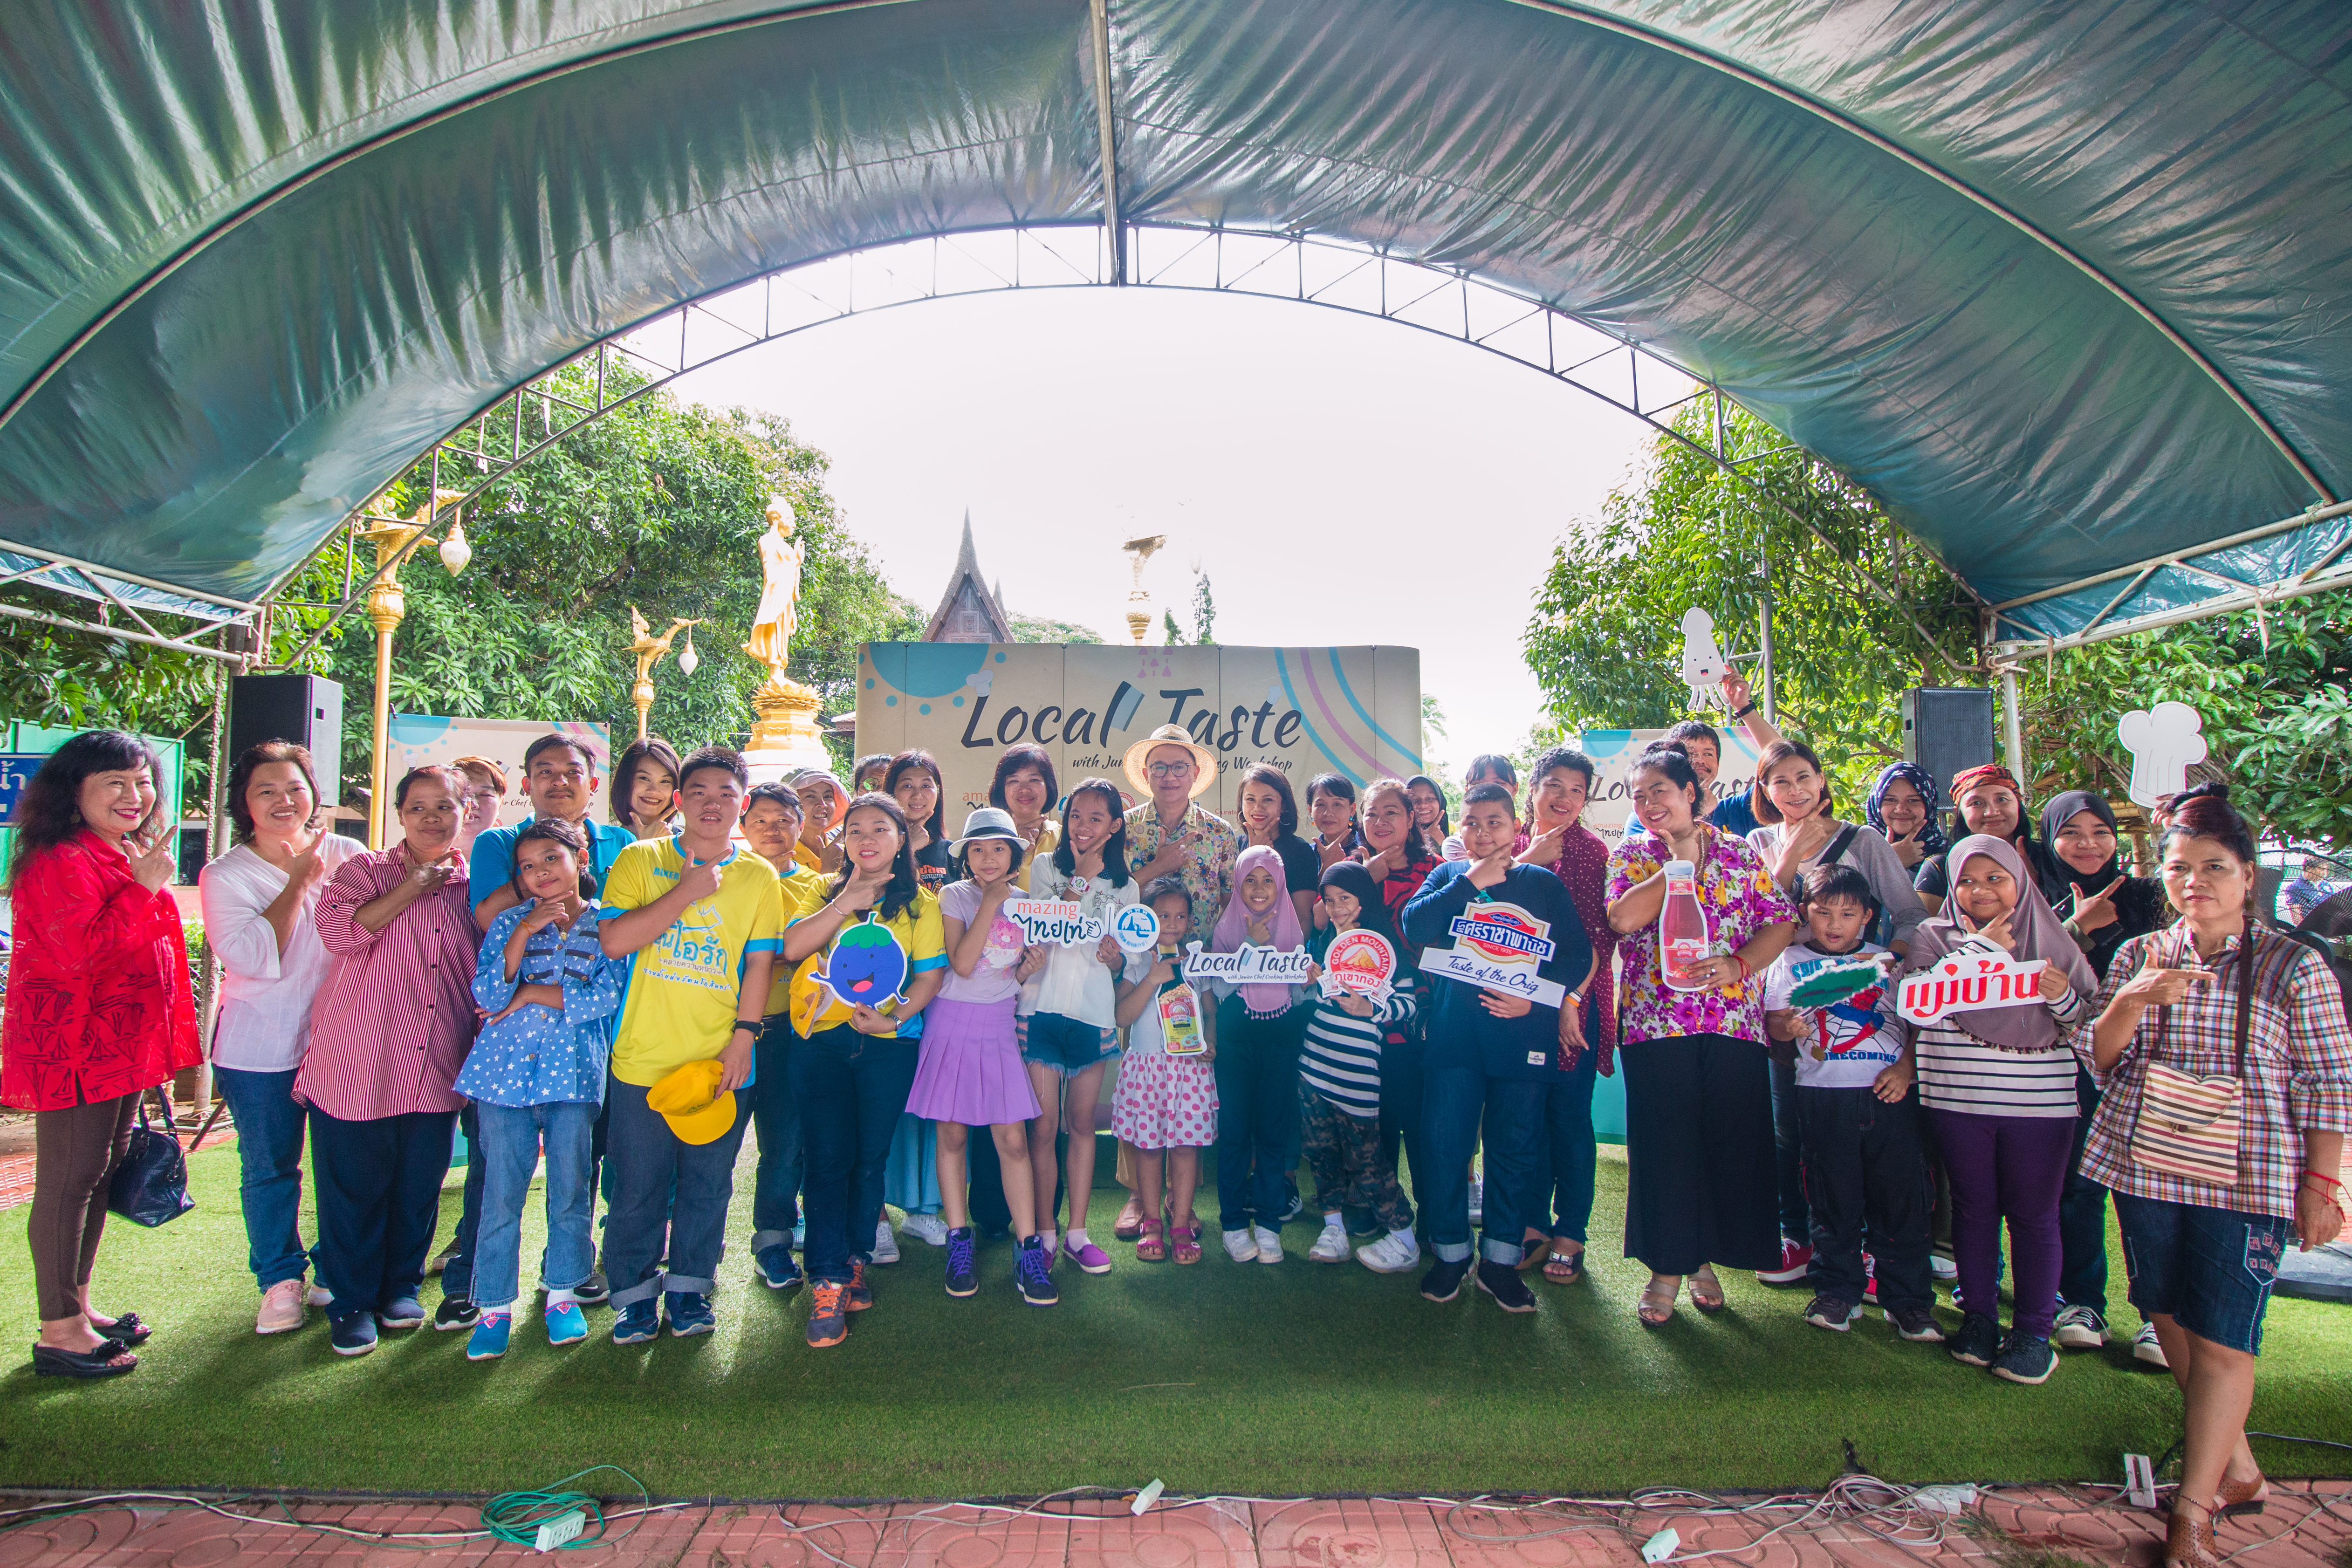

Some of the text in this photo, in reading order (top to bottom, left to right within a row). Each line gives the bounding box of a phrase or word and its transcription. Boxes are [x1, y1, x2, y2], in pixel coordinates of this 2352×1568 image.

[960, 681, 1302, 751] Local Taste
[1072, 754, 1099, 768] with
[1465, 922, 1547, 954] ศรีราชาพานิช
[1188, 947, 1310, 973] Local Taste
[1331, 936, 1389, 973] GOLDEN MOUNTAIN
[1449, 956, 1473, 973] Taste
[1475, 967, 1491, 981] of
[1490, 969, 1506, 982] the
[1905, 960, 2040, 1018] แม่บ้าน
[1824, 1051, 1896, 1065] OMECOMING
